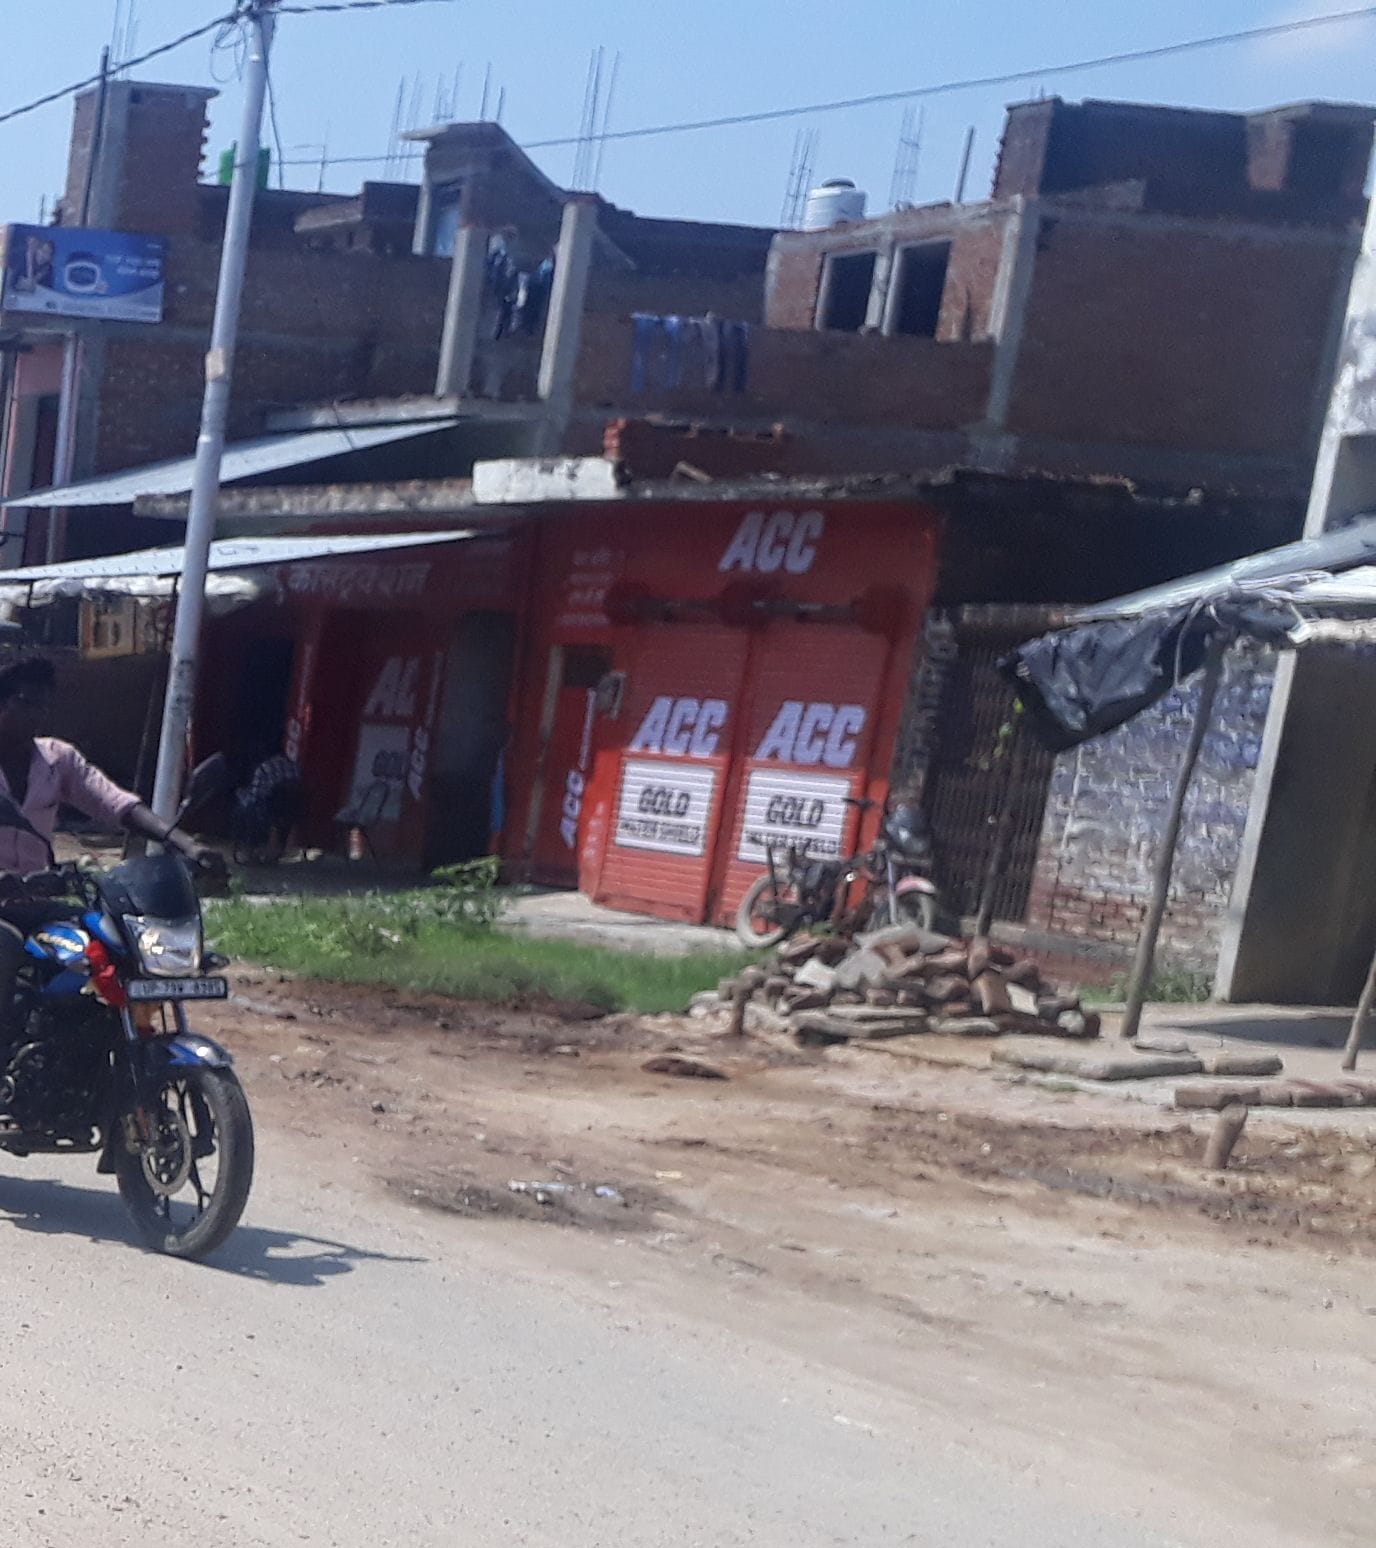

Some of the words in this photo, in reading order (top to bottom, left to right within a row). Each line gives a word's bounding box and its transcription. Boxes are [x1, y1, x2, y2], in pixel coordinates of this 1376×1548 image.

[717, 511, 825, 574] ACC
[628, 696, 729, 758] ACC
[754, 700, 867, 769] ACC
[560, 769, 584, 849] ACC
[638, 785, 691, 818] GOLD
[765, 794, 825, 828] GOLD
